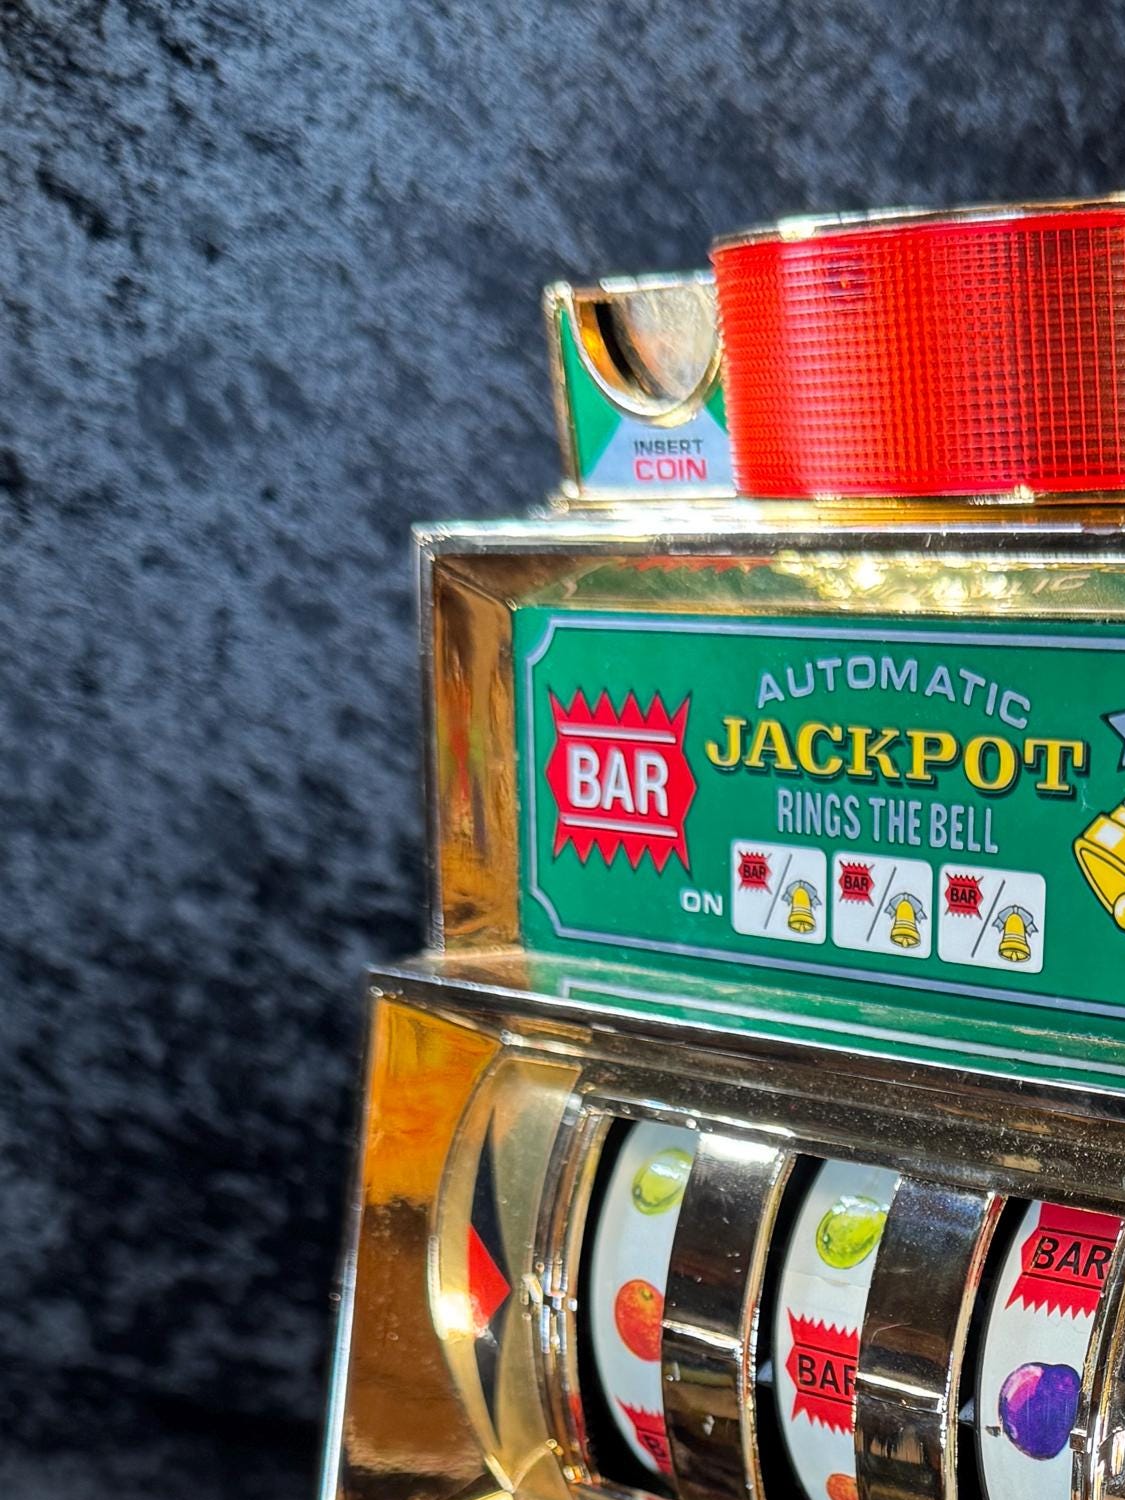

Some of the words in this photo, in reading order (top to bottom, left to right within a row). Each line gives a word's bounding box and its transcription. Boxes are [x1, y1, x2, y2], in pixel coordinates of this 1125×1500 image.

[633, 439, 705, 456] INSERT
[635, 458, 707, 481] COIN
[756, 655, 1032, 730] AUTOMATIC
[705, 716, 1088, 797] JACKPOT
[566, 743, 669, 818] BAR
[776, 788, 862, 840] RINGS
[868, 797, 922, 847] THE
[929, 803, 999, 855] BELL
[742, 863, 769, 879] BAR
[842, 874, 870, 891] BAR
[680, 888, 724, 917] ON
[949, 887, 978, 904] BAR
[1033, 1235, 1113, 1280] BAR
